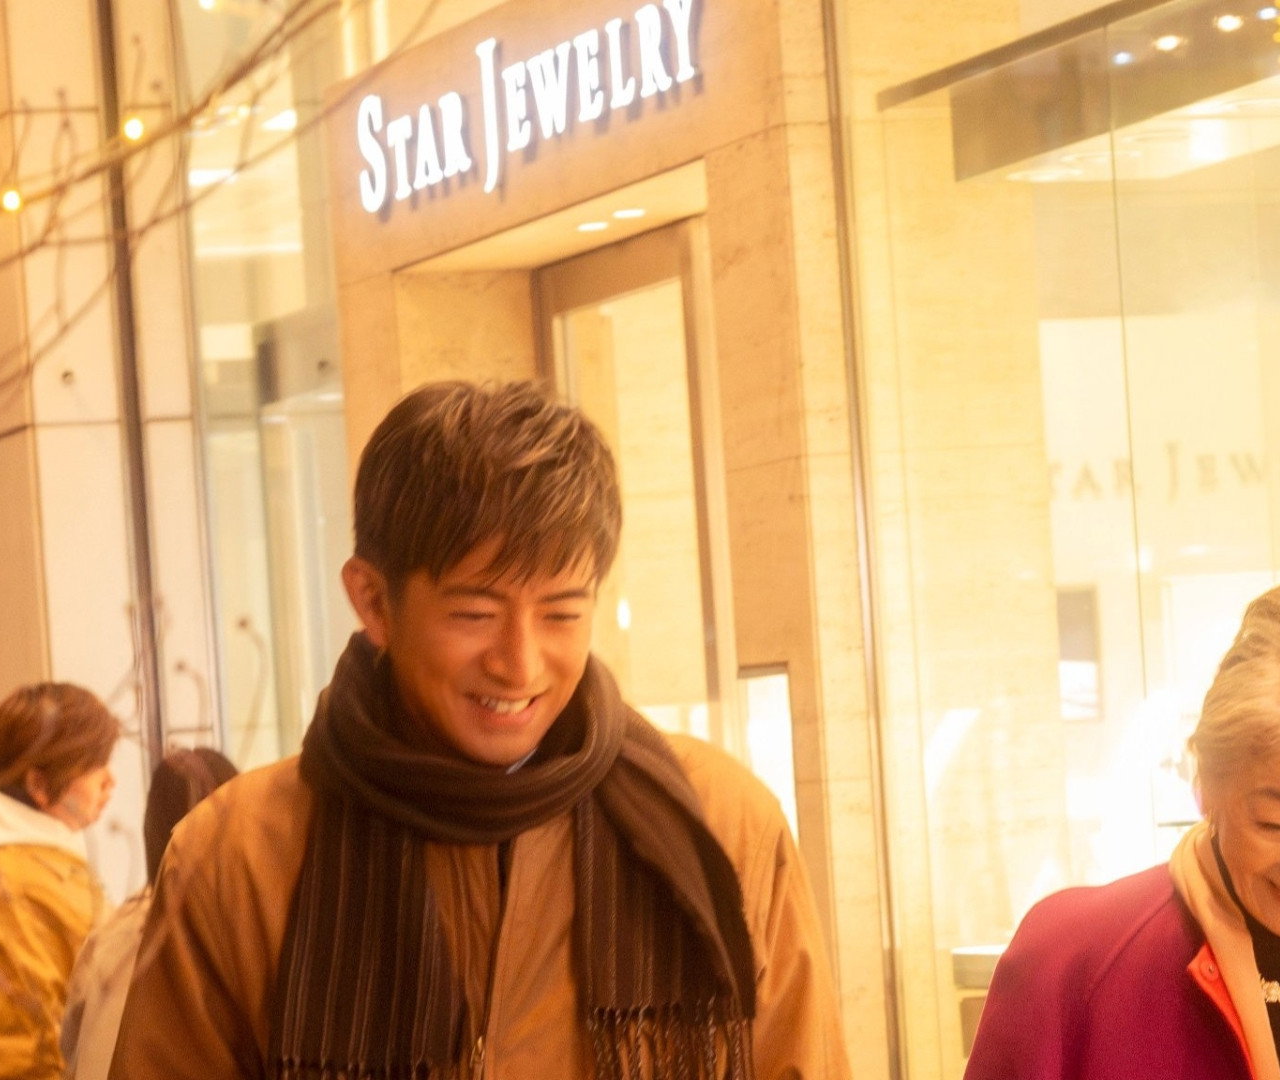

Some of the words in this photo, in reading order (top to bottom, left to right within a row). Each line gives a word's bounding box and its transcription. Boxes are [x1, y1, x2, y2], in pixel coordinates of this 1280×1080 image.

[356, 91, 473, 214] STAR
[475, 0, 696, 194] JEWELRY
[1047, 459, 1142, 501] TAR
